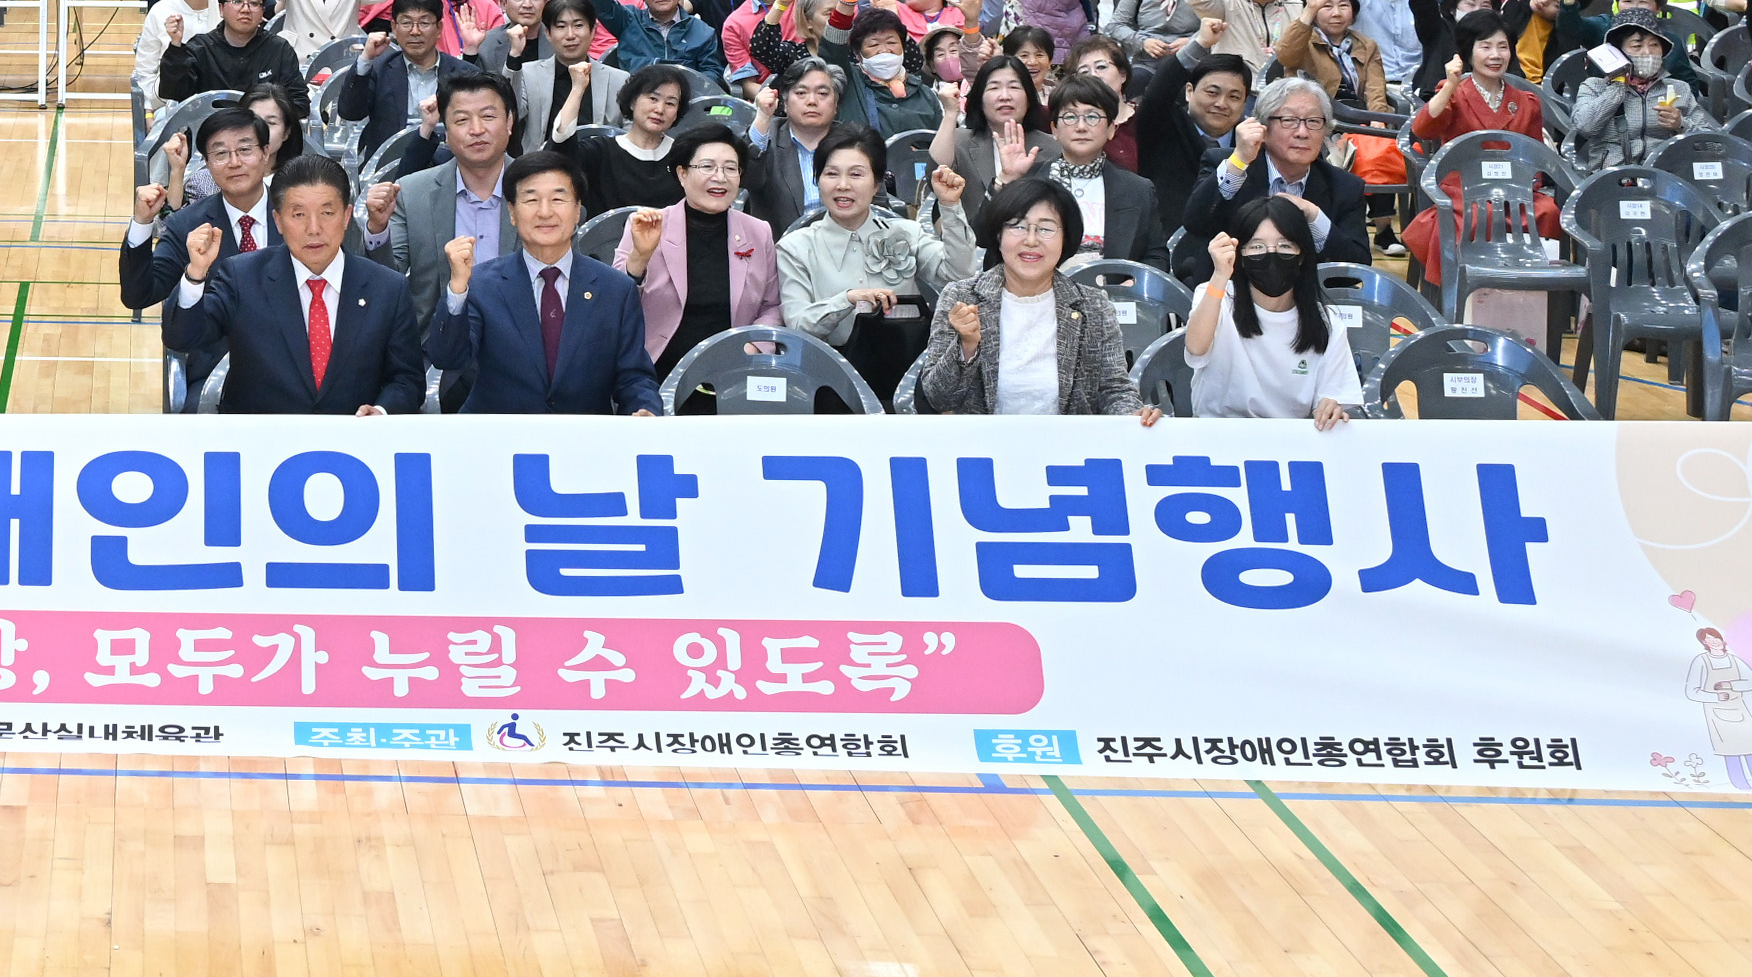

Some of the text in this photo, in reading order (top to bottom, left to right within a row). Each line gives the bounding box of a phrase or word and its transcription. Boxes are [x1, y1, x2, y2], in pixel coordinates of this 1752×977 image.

[756, 384, 777, 393] 도의원
[513, 454, 698, 596] 날
[762, 456, 1548, 609] 기념행사
[84, 624, 330, 695] 모두가
[362, 625, 520, 698] 누릴
[558, 630, 636, 699] 수
[672, 627, 957, 702] 있도록”
[562, 731, 909, 759] 진주시장애인총연합회
[991, 733, 1062, 762] 후원
[1097, 736, 1582, 771] 진주시장애인총연합회 후원회
